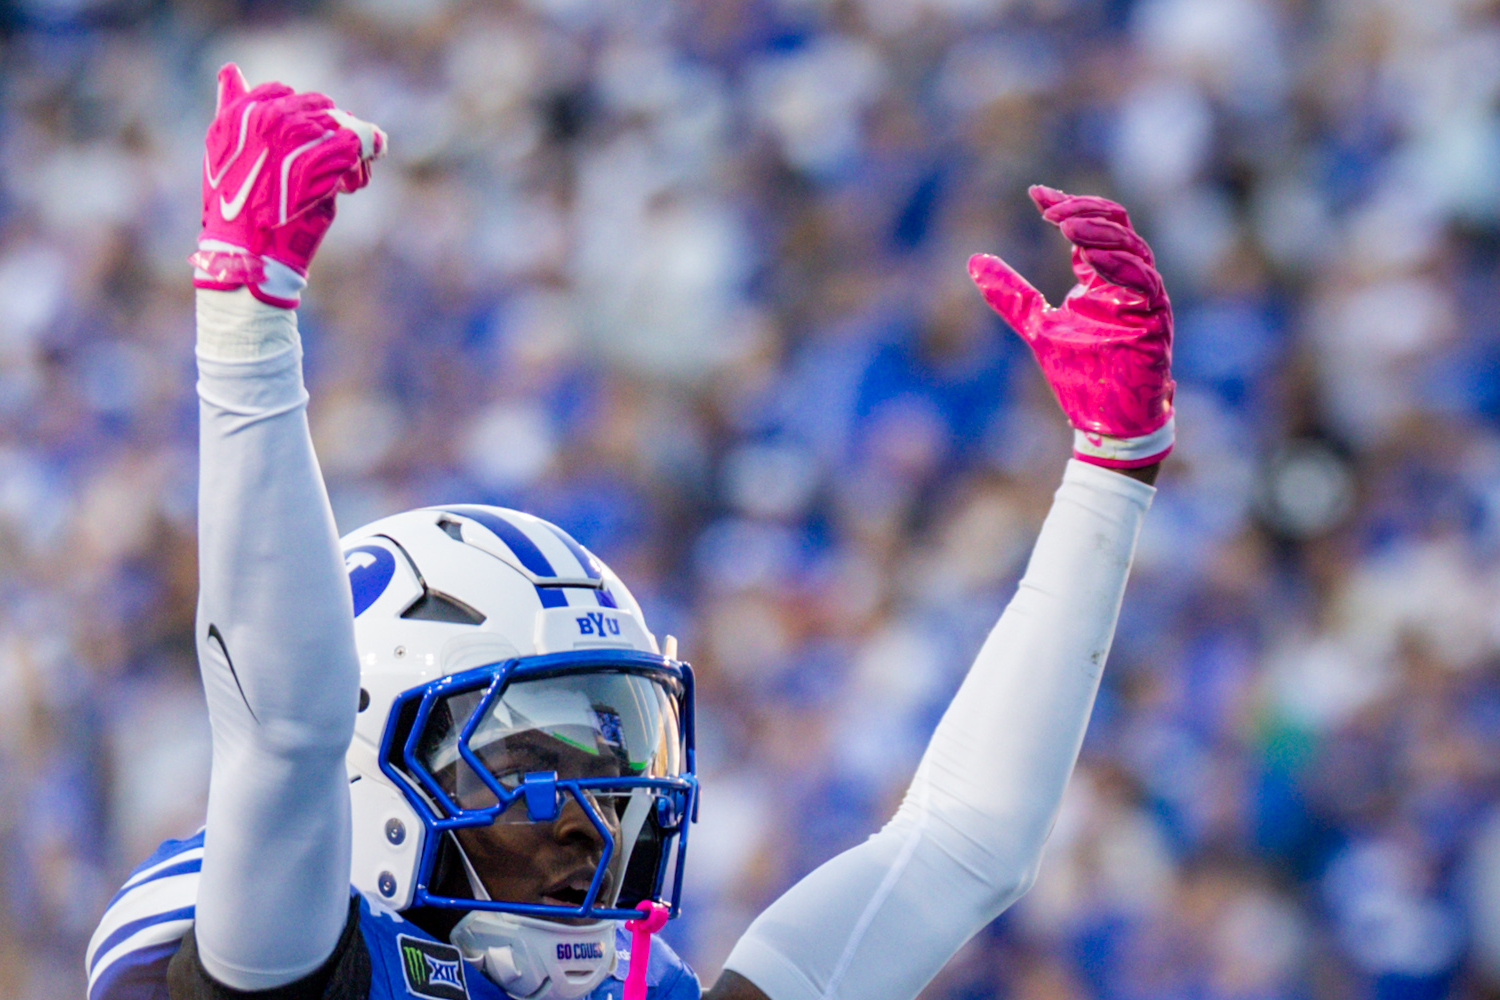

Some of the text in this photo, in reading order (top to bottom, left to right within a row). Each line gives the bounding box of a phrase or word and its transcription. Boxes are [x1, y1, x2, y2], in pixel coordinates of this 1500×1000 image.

[575, 611, 621, 638] BYU
[556, 943, 572, 960] GO
[573, 942, 603, 960] COUGS
[427, 957, 462, 988] XII
